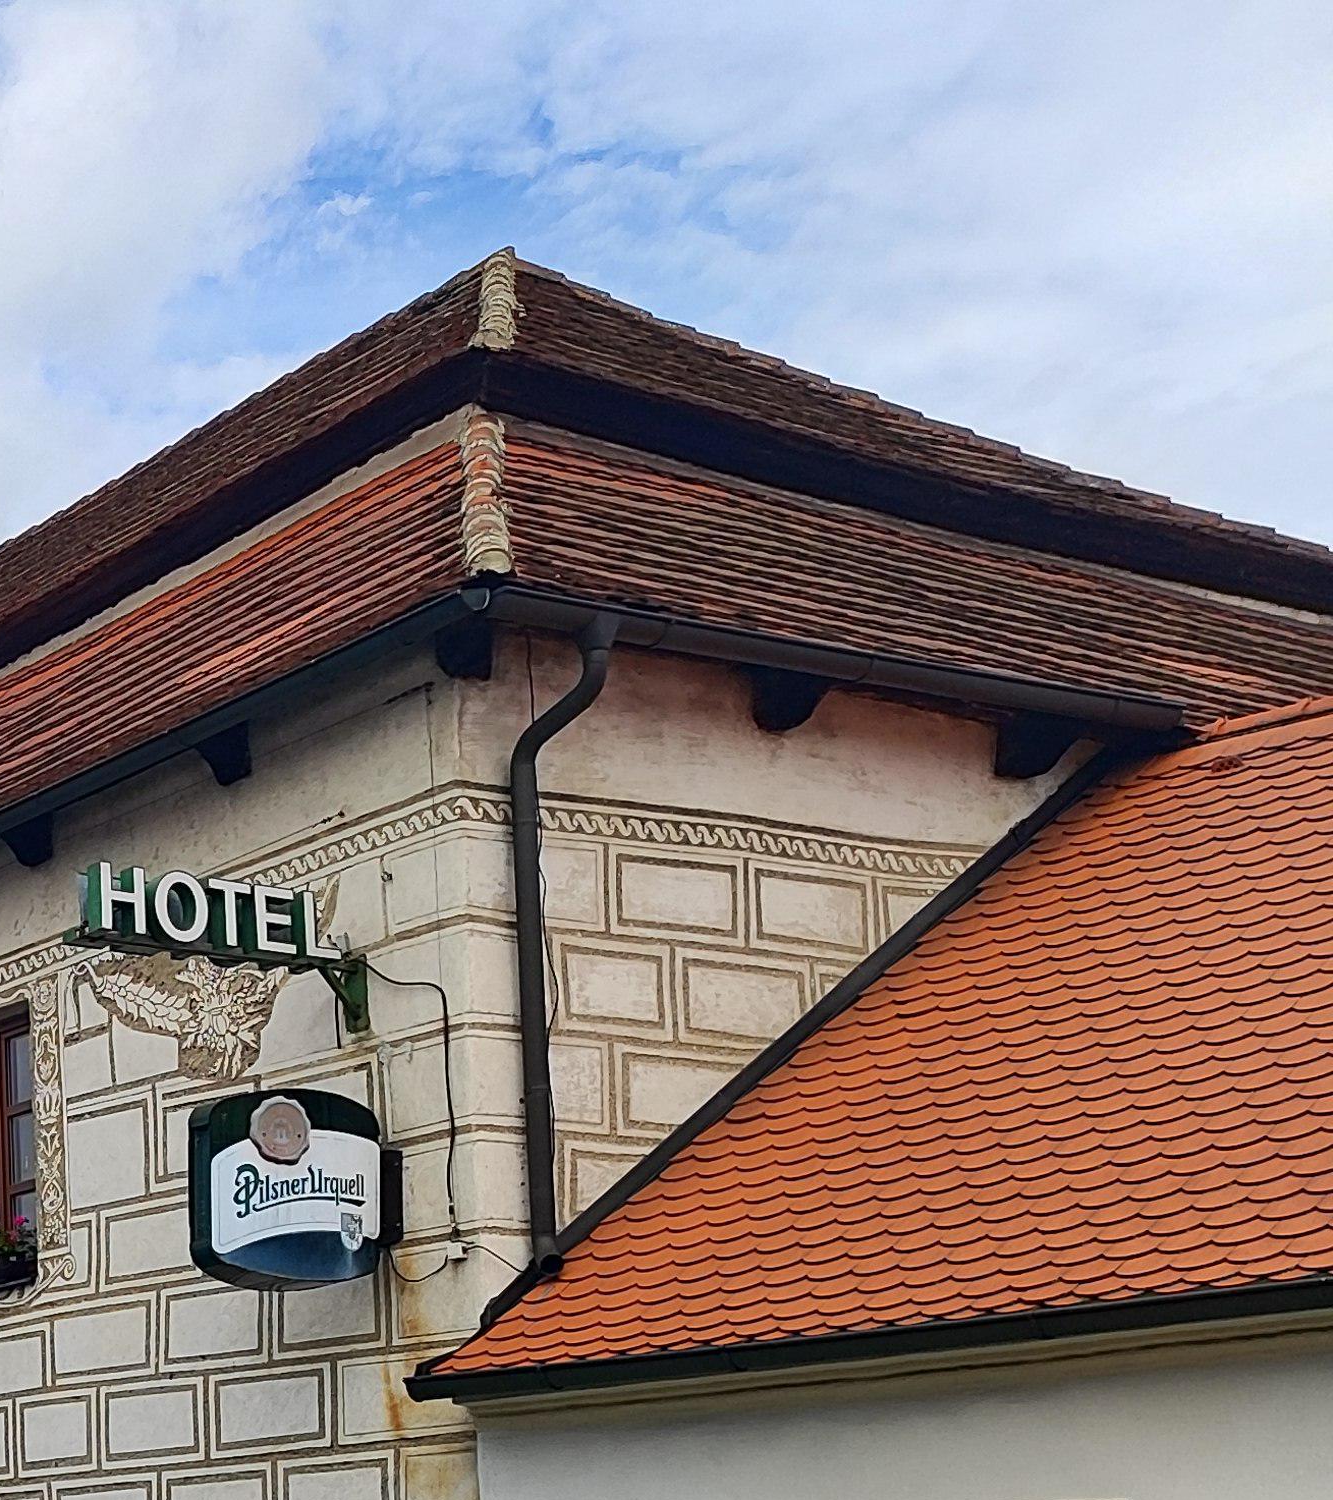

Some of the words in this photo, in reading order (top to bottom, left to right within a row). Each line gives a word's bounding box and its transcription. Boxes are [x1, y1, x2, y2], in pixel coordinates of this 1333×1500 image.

[97, 861, 342, 960] HOTEL
[233, 1164, 309, 1218] Pilsner
[308, 1165, 365, 1206] Urquell
